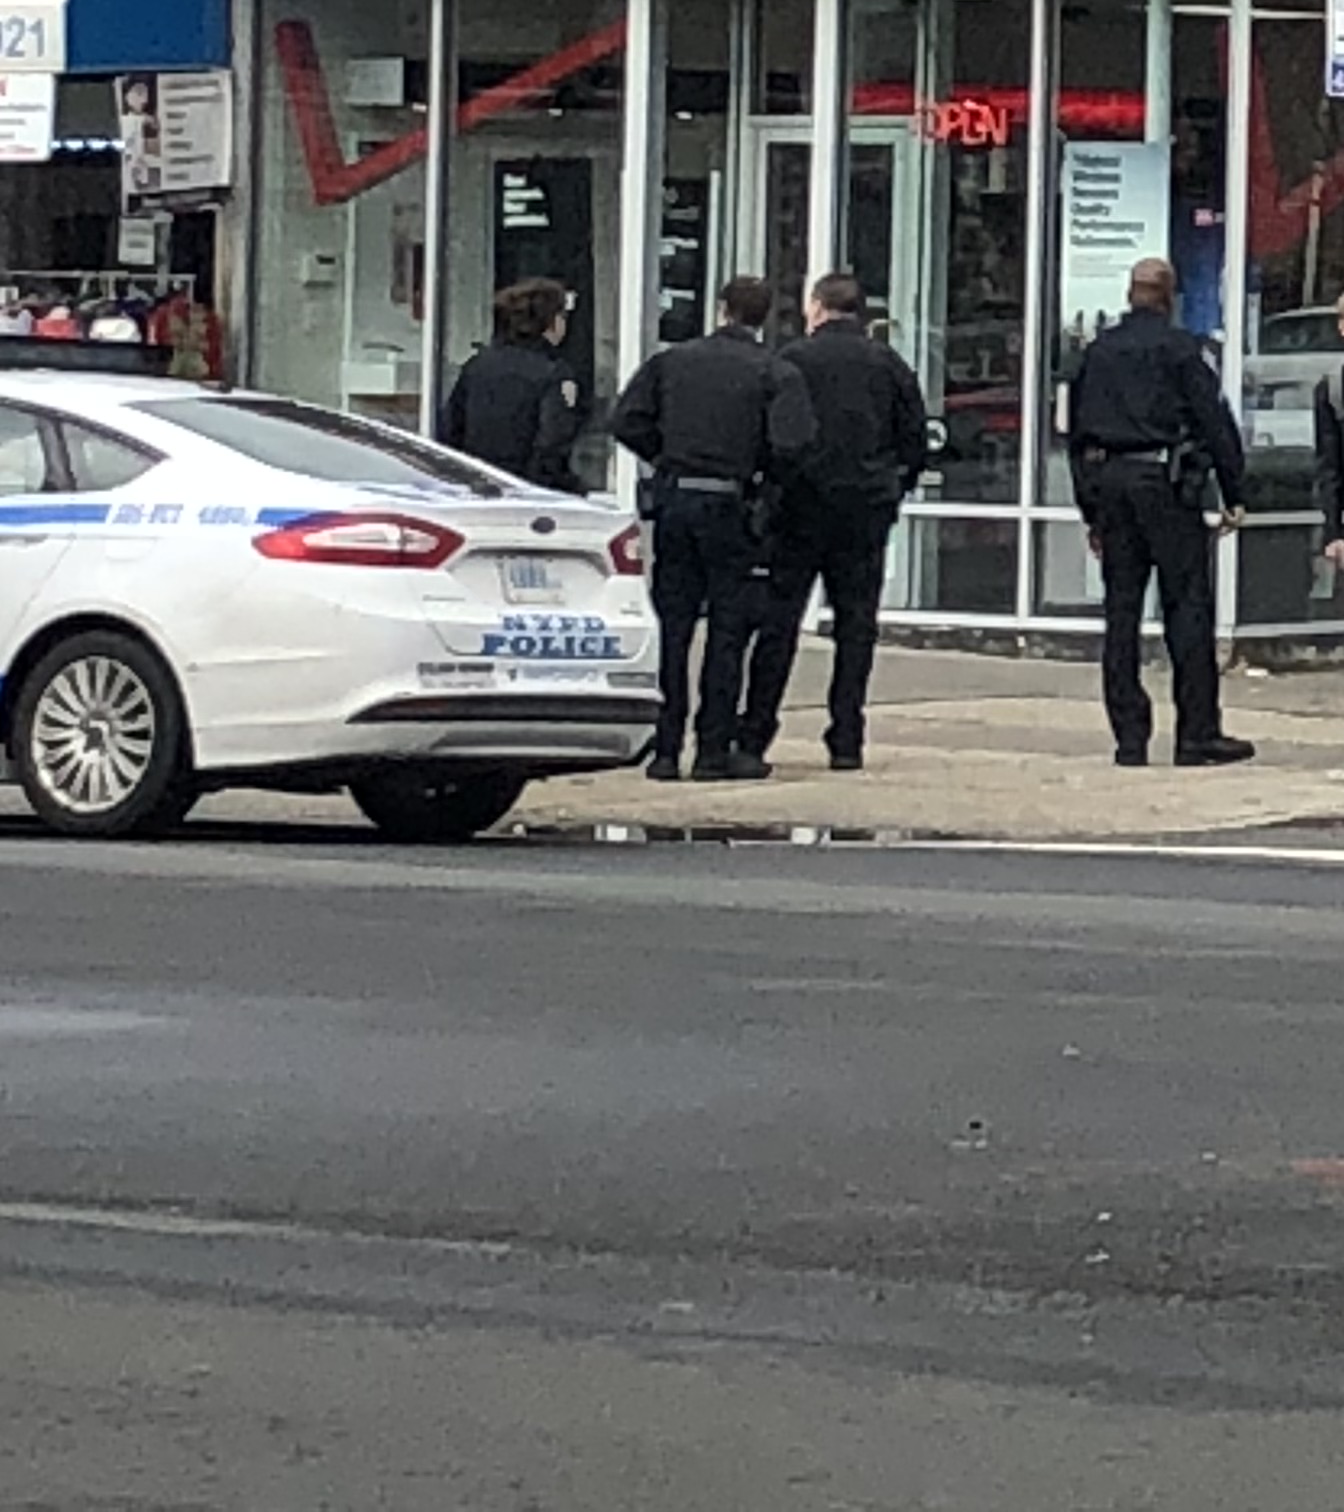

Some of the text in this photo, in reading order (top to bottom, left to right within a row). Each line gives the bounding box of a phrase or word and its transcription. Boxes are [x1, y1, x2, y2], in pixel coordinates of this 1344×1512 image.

[0, 15, 45, 58] 21
[502, 614, 606, 632] NYPD
[481, 633, 623, 659] POLICE
